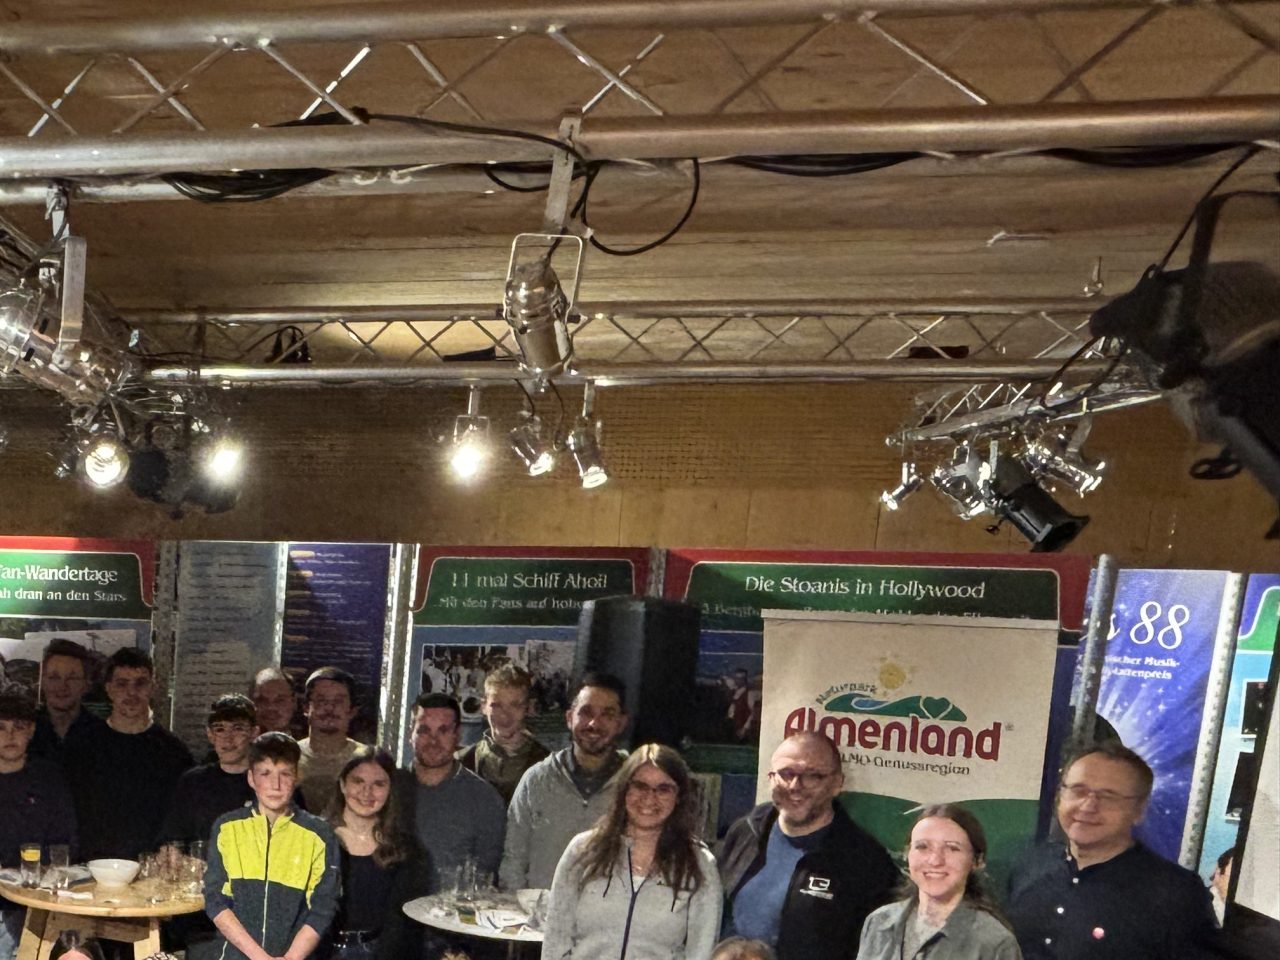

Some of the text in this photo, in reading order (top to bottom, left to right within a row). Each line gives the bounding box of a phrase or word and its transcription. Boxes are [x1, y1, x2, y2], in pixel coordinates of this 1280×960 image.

[477, 572, 507, 588] mal
[512, 572, 562, 589] Schiff
[745, 576, 986, 600] Die Stoanis in Hollywood
[14, 588, 43, 601] dran
[46, 590, 62, 601] an
[66, 590, 90, 601] den
[1129, 600, 1191, 650] 88
[783, 706, 1003, 762] Almenland
